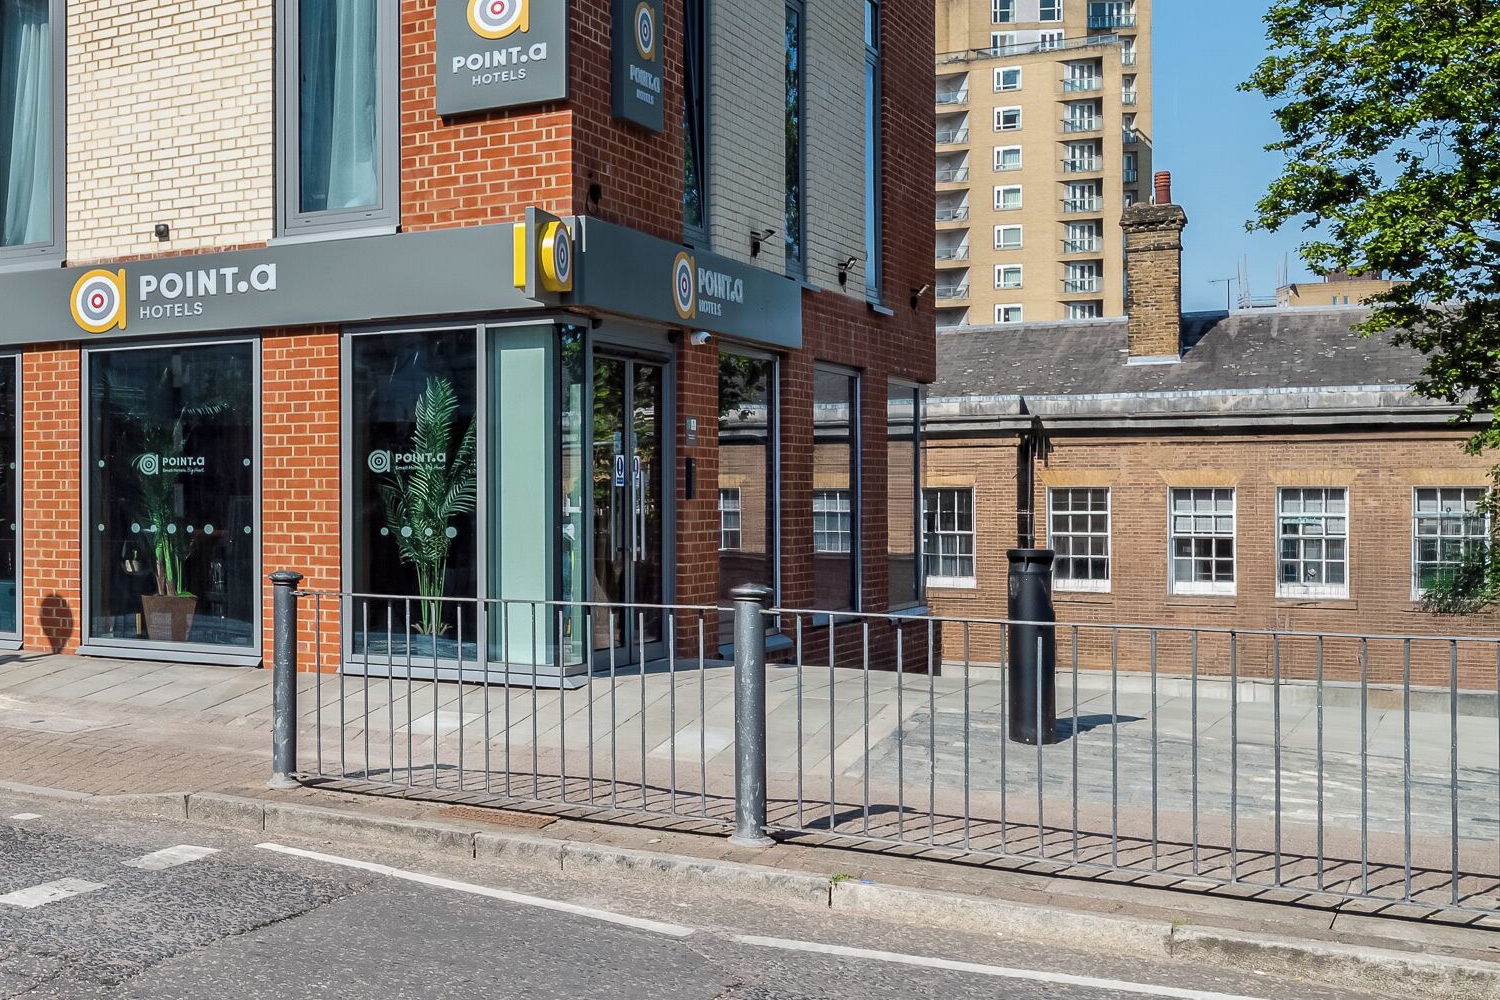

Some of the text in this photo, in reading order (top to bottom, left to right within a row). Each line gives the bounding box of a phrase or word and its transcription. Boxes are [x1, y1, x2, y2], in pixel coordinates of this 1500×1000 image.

[452, 42, 547, 74] POINT.a
[472, 68, 527, 86] HOTELS
[139, 263, 277, 302] POINT.a
[698, 267, 744, 304] POINT.a
[139, 301, 203, 319] HOTELS
[698, 299, 722, 317] HOTELS
[162, 456, 205, 466] POINT.a
[395, 453, 446, 463] POINT.a
